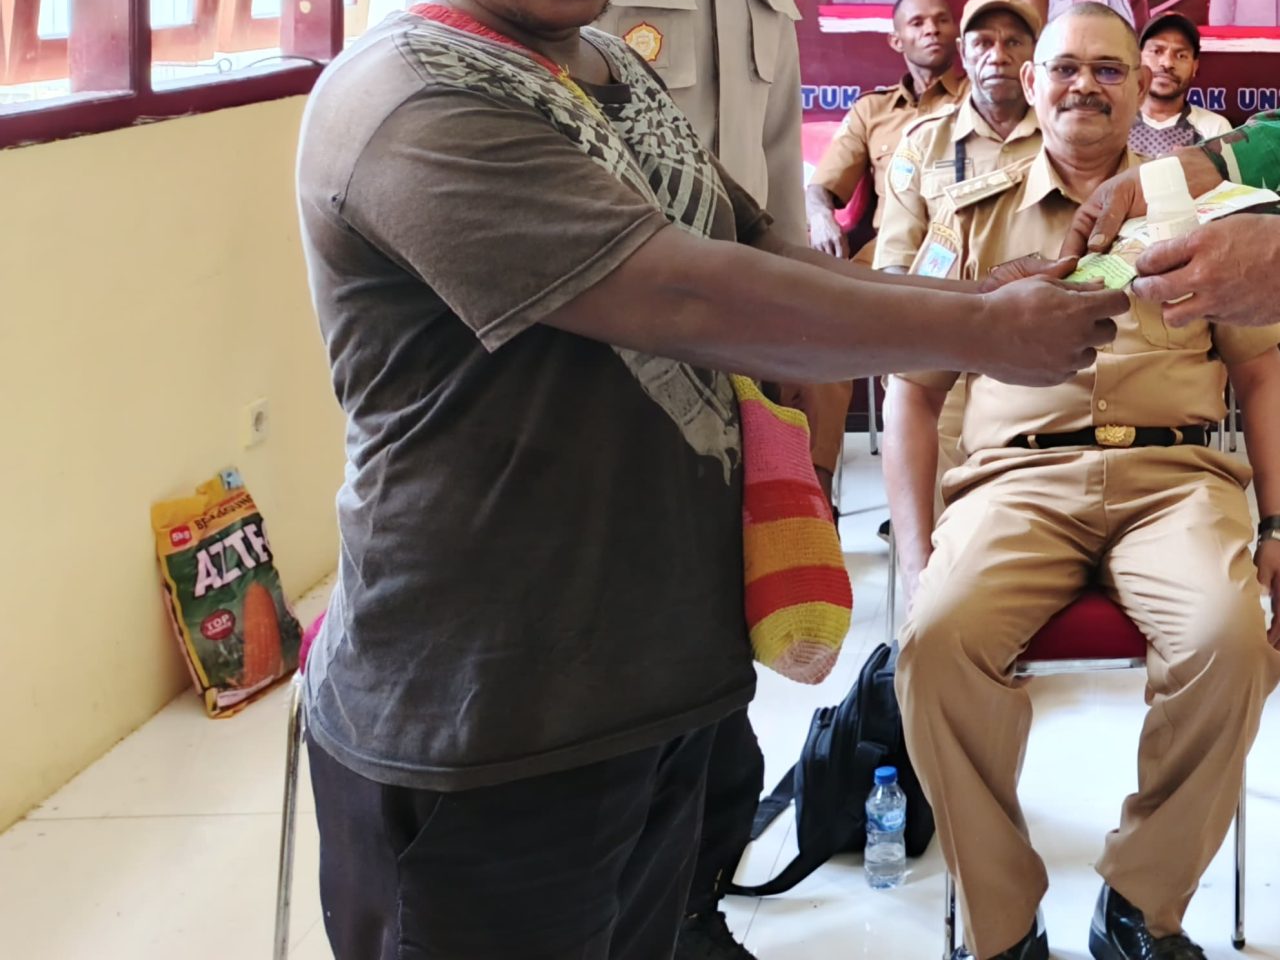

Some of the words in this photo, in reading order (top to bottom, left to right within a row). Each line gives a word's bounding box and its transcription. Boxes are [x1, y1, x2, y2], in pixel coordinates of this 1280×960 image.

[801, 86, 861, 109] TUK
[1187, 88, 1227, 110] AK
[205, 613, 230, 630] TOP
